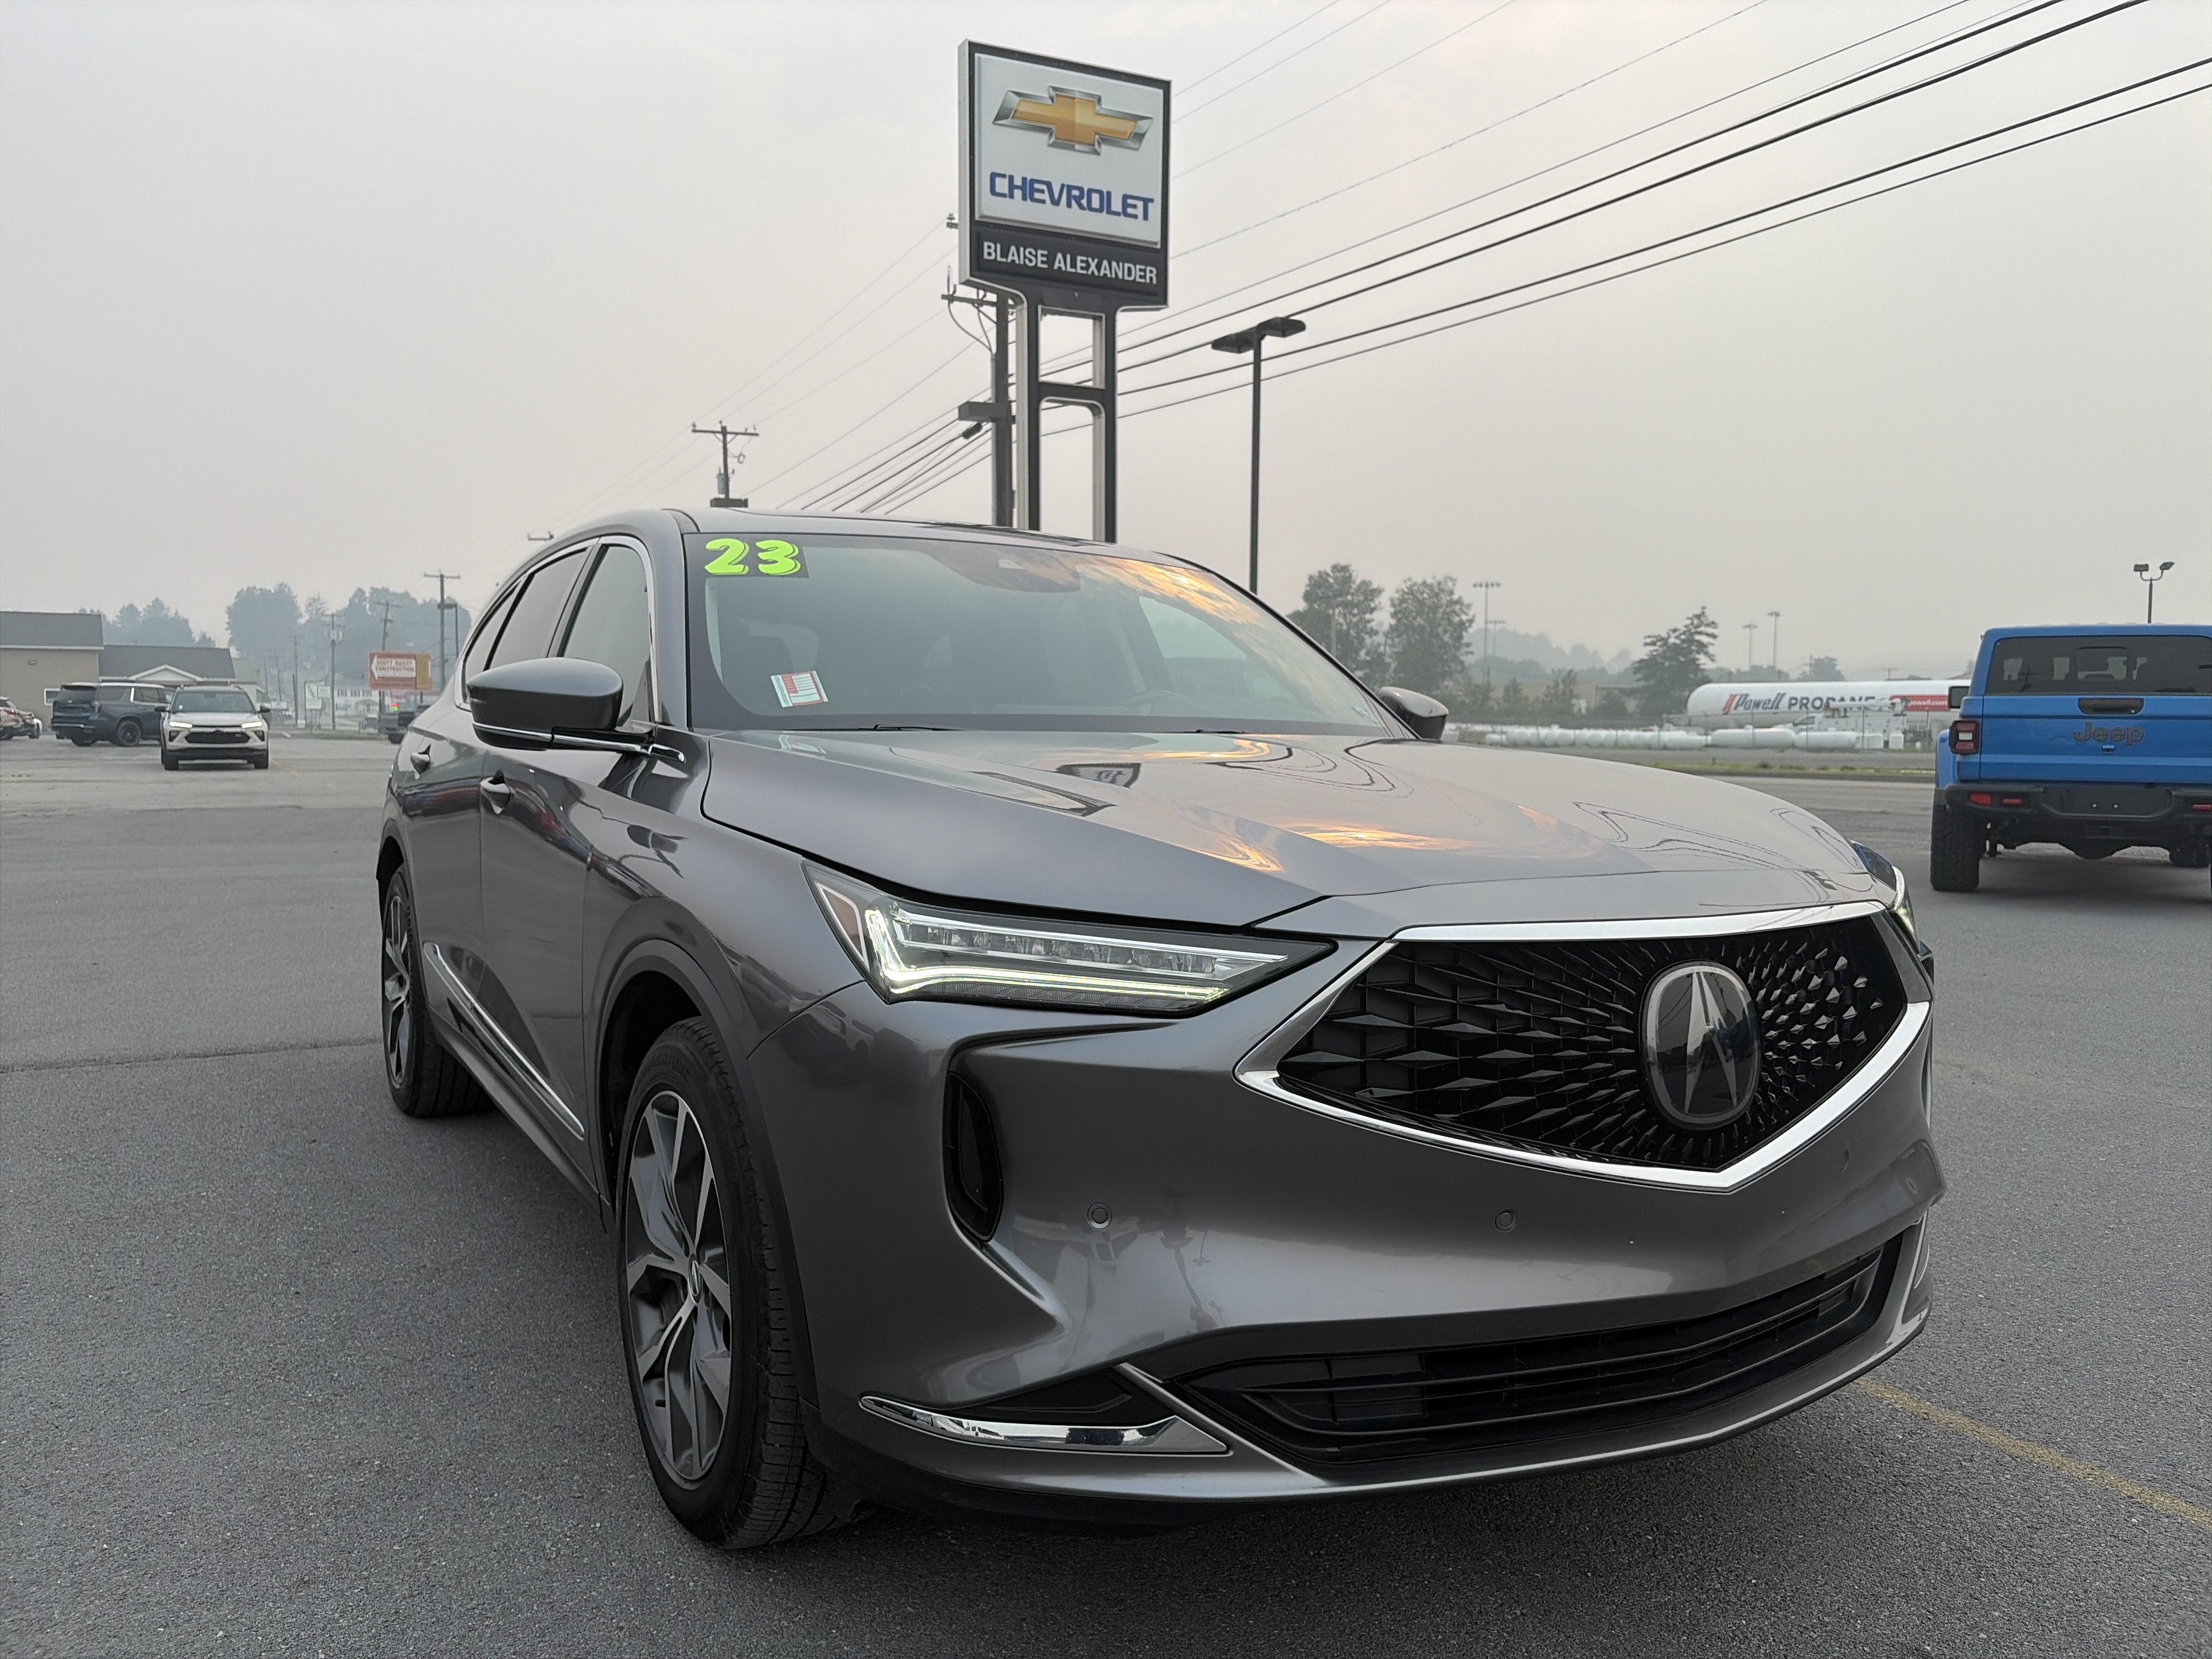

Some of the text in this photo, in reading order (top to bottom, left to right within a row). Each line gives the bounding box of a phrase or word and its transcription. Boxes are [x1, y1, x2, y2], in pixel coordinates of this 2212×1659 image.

[990, 172, 1154, 221] CHEVROLET
[983, 241, 1157, 284] BLAISE ALEXANDER
[704, 538, 801, 575] 23
[1733, 692, 1786, 712] Powell
[2073, 721, 2145, 746] Jeep
